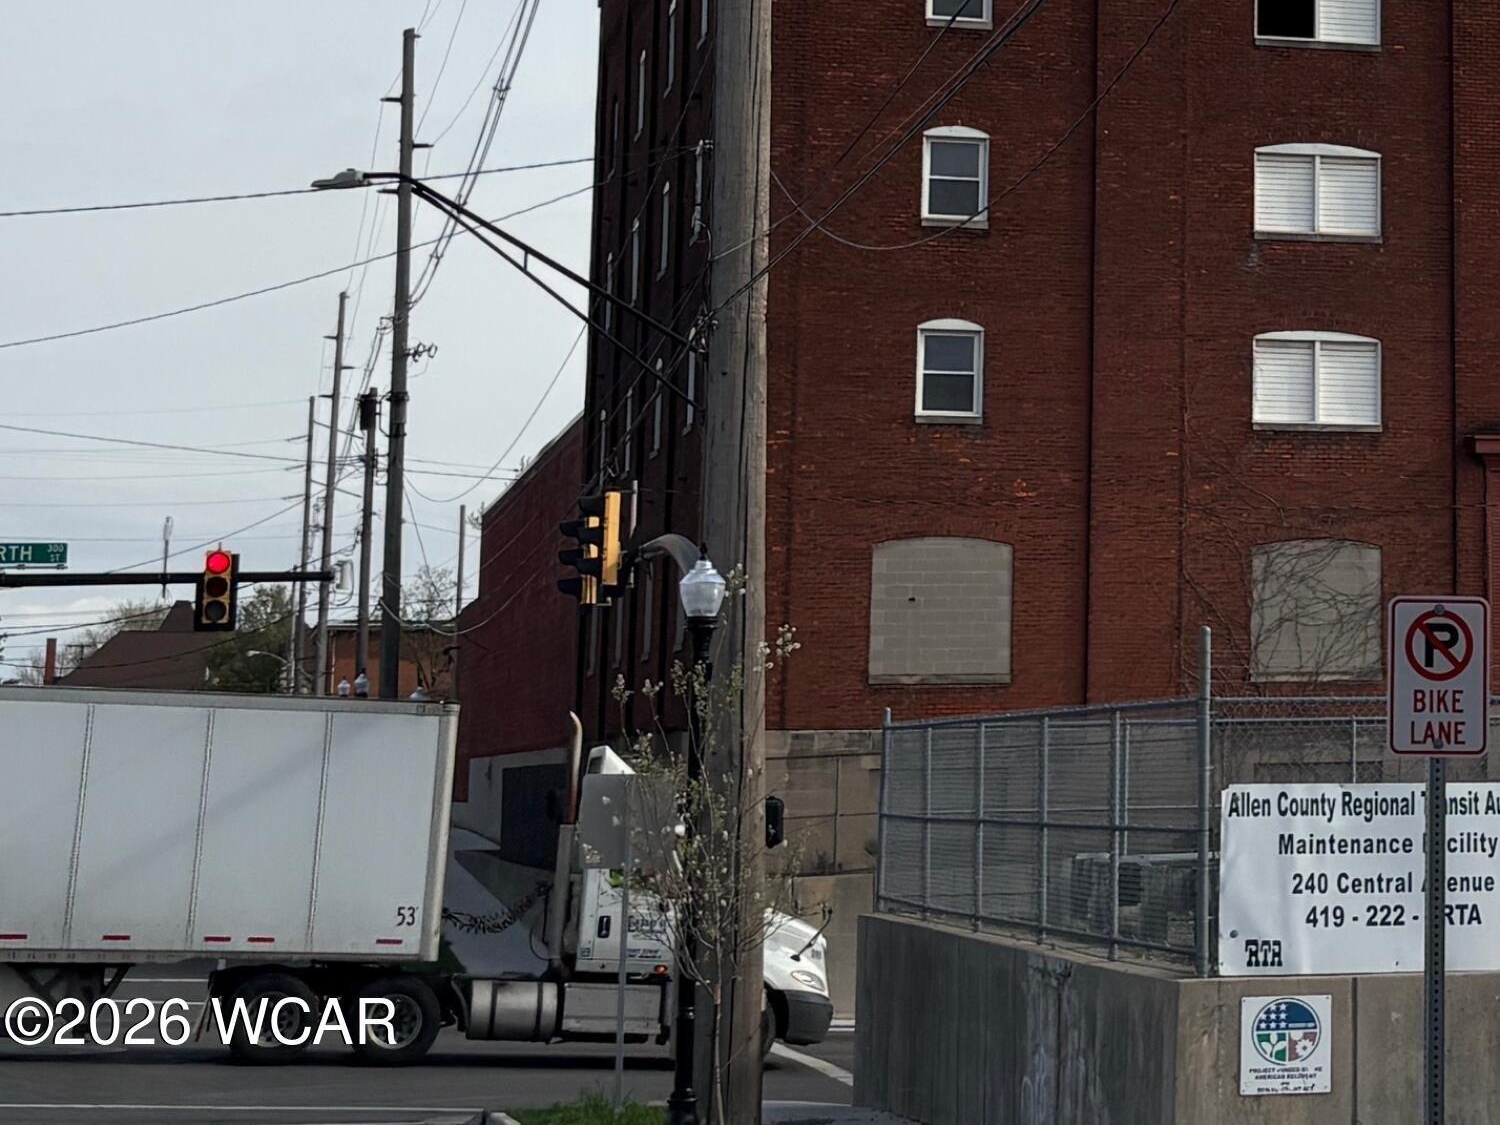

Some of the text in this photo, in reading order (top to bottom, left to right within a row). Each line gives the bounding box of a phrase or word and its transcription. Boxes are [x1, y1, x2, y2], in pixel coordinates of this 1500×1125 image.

[1413, 689, 1464, 714] BIKE
[1410, 721, 1466, 745] LANE
[1228, 791, 1272, 817] Allen
[1277, 791, 1336, 823] County
[1341, 791, 1416, 823] Regional
[1421, 791, 1480, 816] nsit
[1278, 832, 1499, 858] Maintenance cility
[1292, 871, 1496, 895] 240 Central enue
[1305, 905, 1345, 928] 419
[1365, 905, 1406, 927] 222
[1439, 904, 1483, 925] RTA
[1244, 939, 1283, 967] RTA
